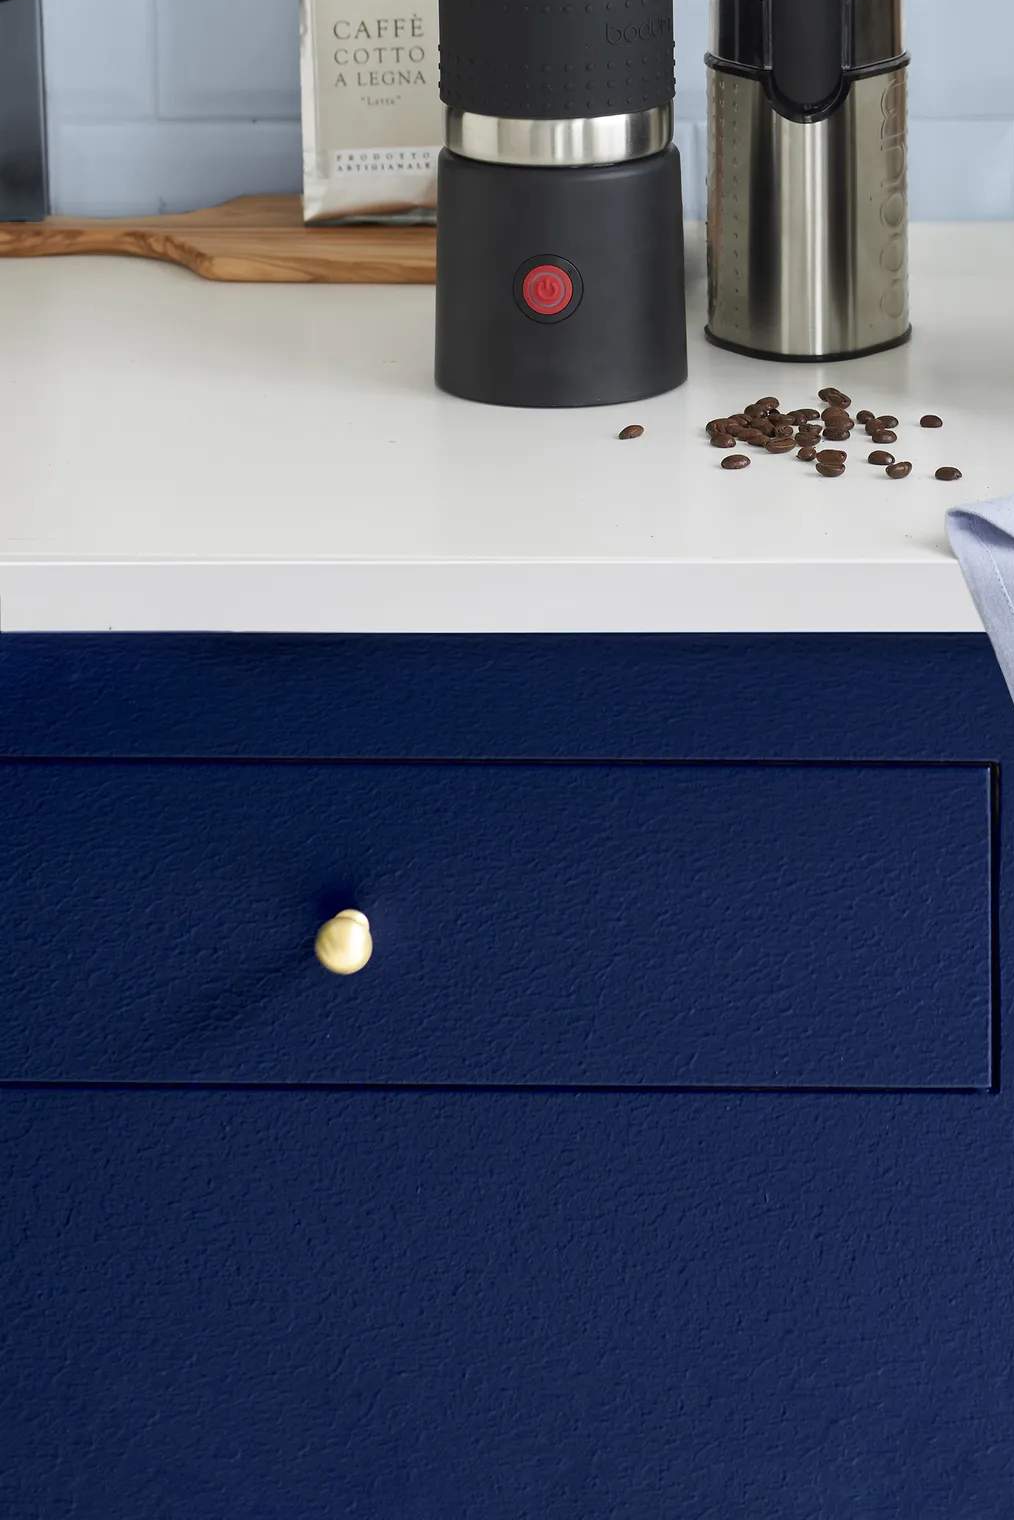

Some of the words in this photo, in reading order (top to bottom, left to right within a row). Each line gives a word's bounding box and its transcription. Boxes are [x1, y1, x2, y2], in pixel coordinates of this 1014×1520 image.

[332, 14, 425, 40] CAFFÈ
[333, 45, 426, 66] COTTO
[333, 71, 348, 88] A
[356, 69, 427, 88] LEGNA
